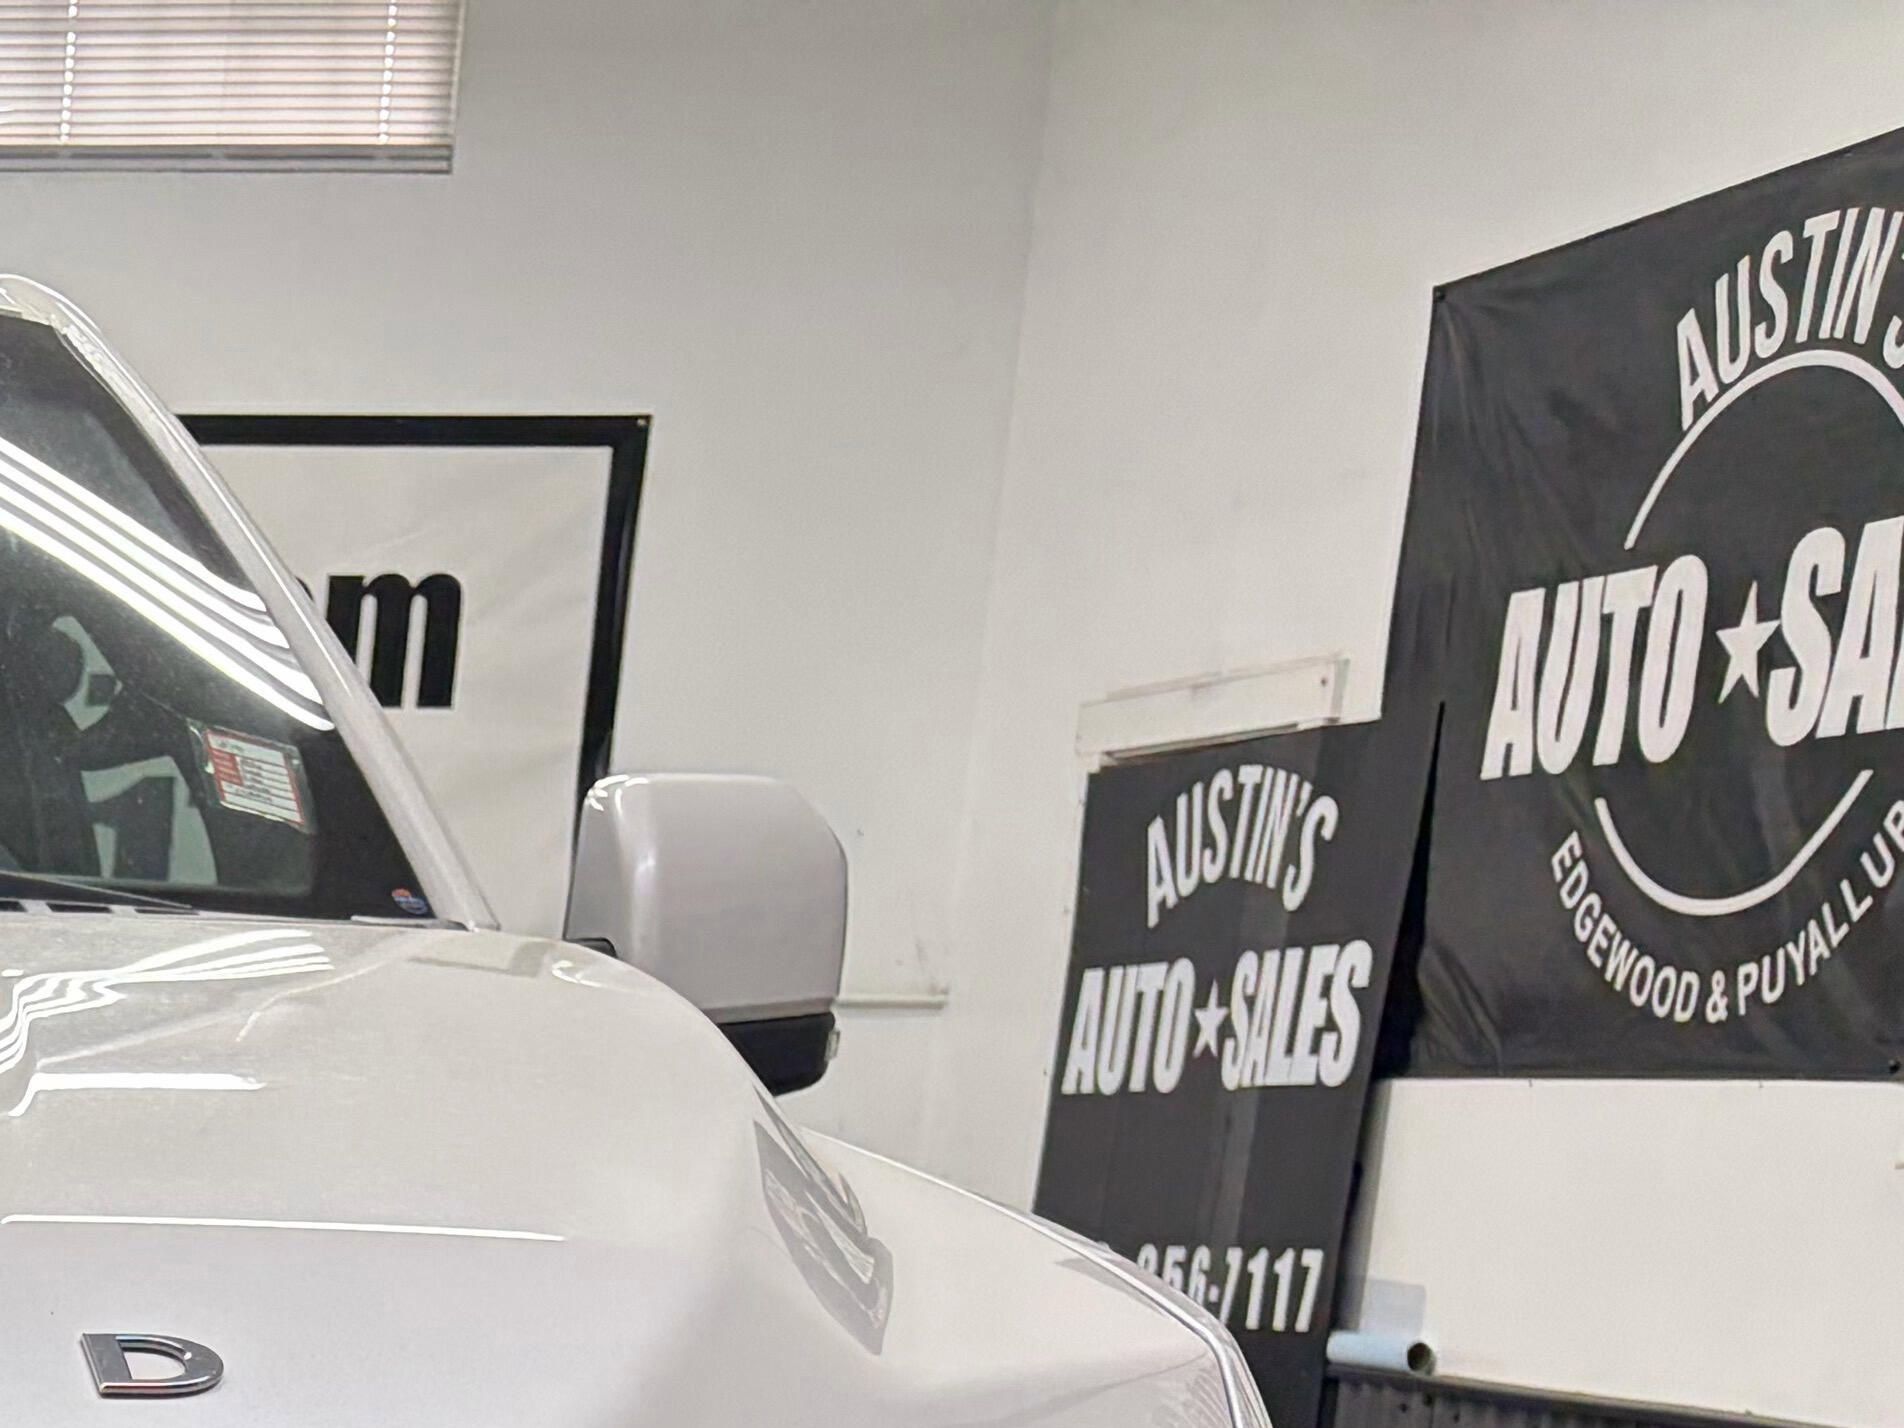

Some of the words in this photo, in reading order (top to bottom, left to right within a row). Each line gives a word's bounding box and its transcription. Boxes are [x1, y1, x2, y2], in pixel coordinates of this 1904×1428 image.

[1677, 207, 1904, 431] AUSTIN
[1480, 554, 1708, 780] AUTO
[1147, 764, 1339, 928] AUSTIN'S
[1550, 830, 1700, 1023] EDGEWOOD
[1705, 969, 1728, 1024] &
[1061, 957, 1196, 1096] AUTO
[1221, 940, 1373, 1091] SALES
